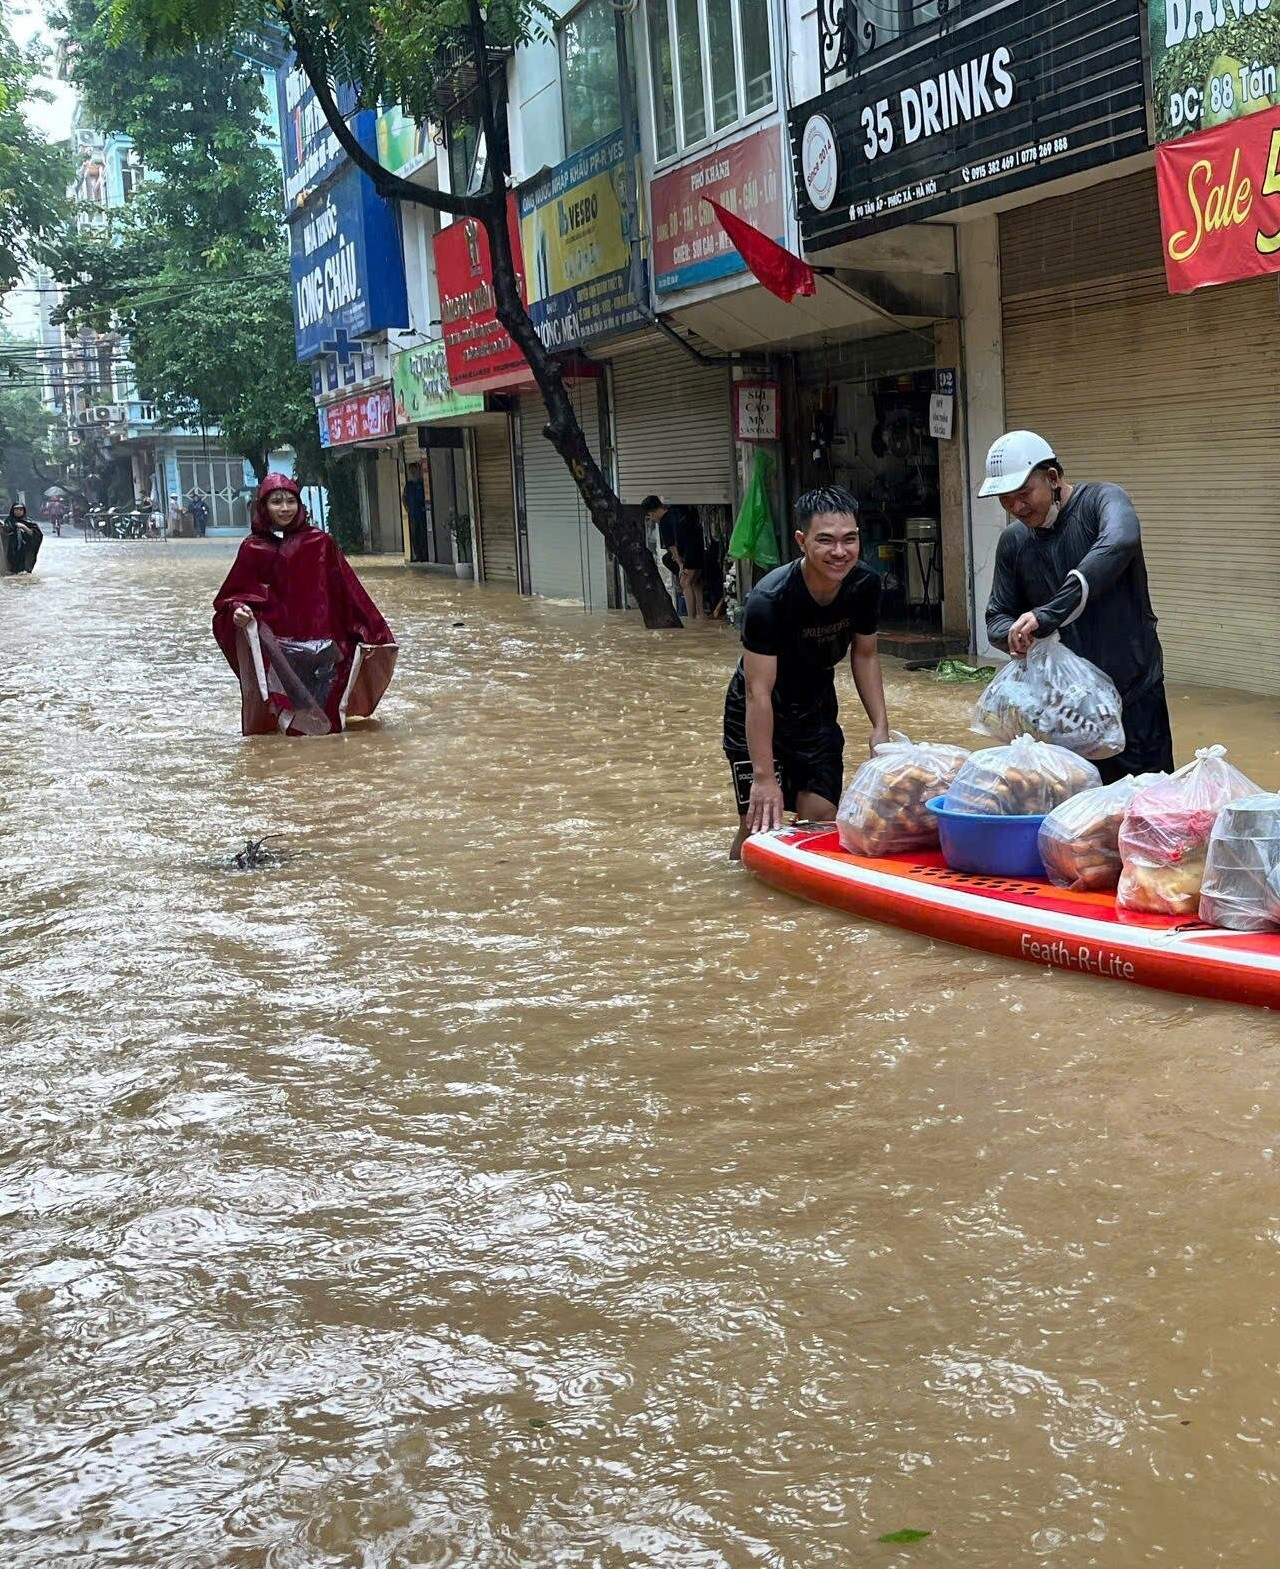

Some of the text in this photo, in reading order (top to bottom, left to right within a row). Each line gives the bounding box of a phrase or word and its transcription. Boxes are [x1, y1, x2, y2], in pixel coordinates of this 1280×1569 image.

[861, 46, 1015, 160] 35 DRINKS
[1170, 87, 1205, 127] ĐC:
[1210, 73, 1233, 113] 88
[1239, 60, 1277, 103] Tân
[819, 138, 832, 165] 2014
[971, 166, 986, 180] 0915
[1002, 155, 1015, 171] 469
[1039, 142, 1052, 158] 269
[569, 193, 598, 230] VESBO
[1168, 148, 1253, 261] Sale
[296, 266, 324, 330] LONG
[939, 371, 953, 387] 92
[1020, 933, 1135, 980] Feath-R-Lite
